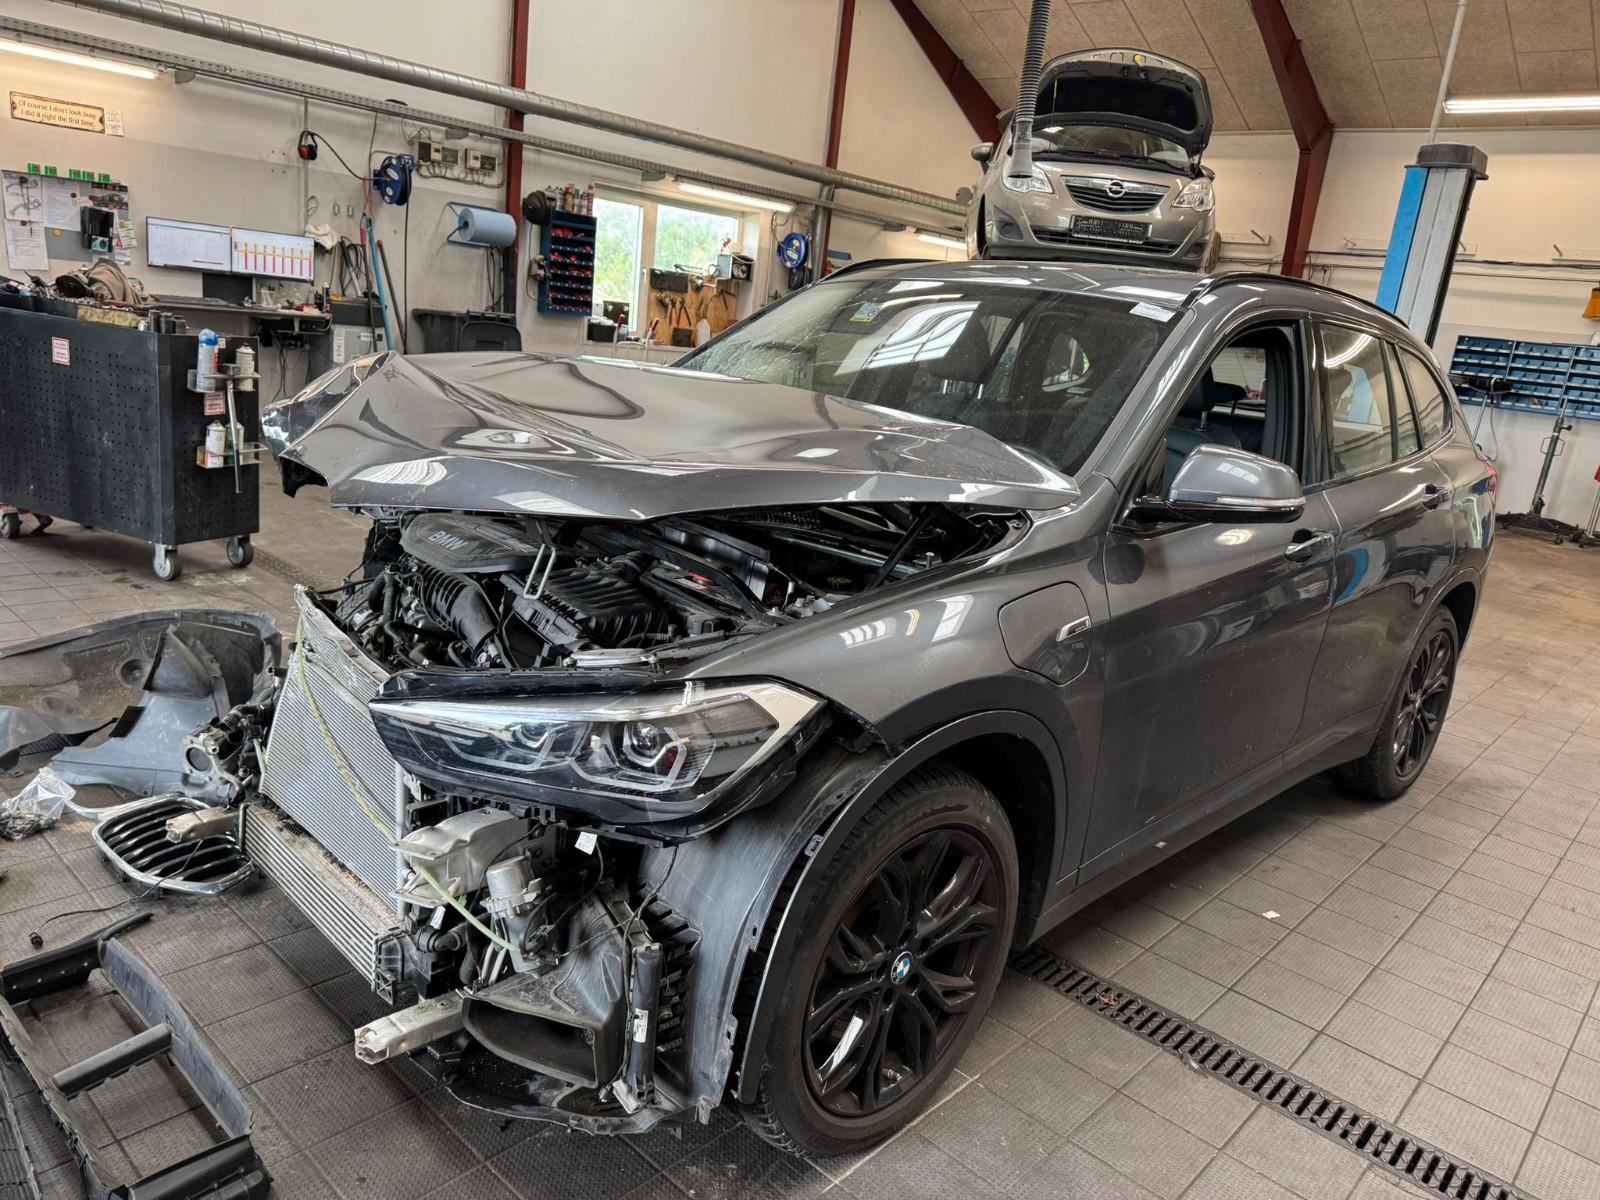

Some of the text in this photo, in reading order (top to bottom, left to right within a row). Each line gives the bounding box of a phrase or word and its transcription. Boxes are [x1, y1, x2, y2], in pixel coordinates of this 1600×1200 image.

[27, 102, 48, 111] course
[52, 104, 68, 114] don't
[69, 108, 82, 117] look
[42, 113, 56, 121] right
[68, 117, 80, 125] first
[428, 530, 468, 550] BMW
